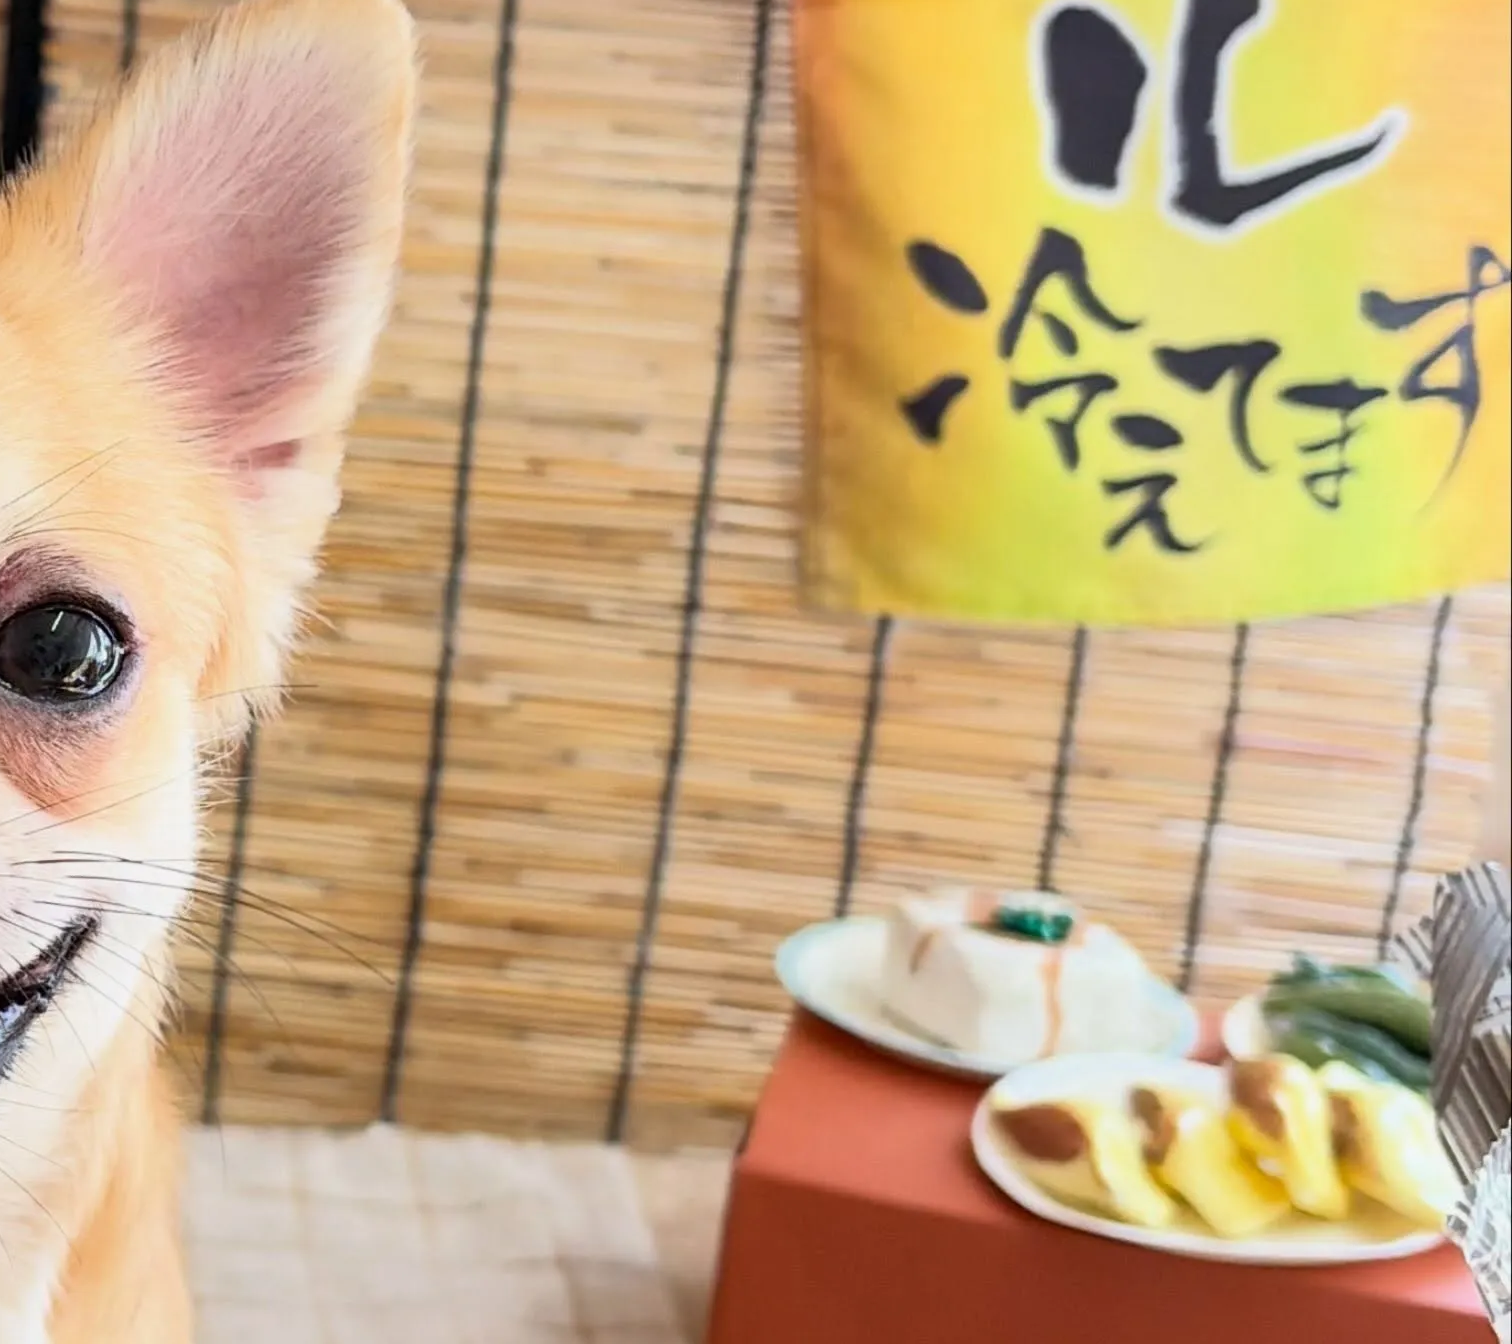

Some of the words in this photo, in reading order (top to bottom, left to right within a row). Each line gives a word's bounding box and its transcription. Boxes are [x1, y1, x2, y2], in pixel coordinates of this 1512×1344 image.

[900, 228, 1512, 552] 冷えてます
